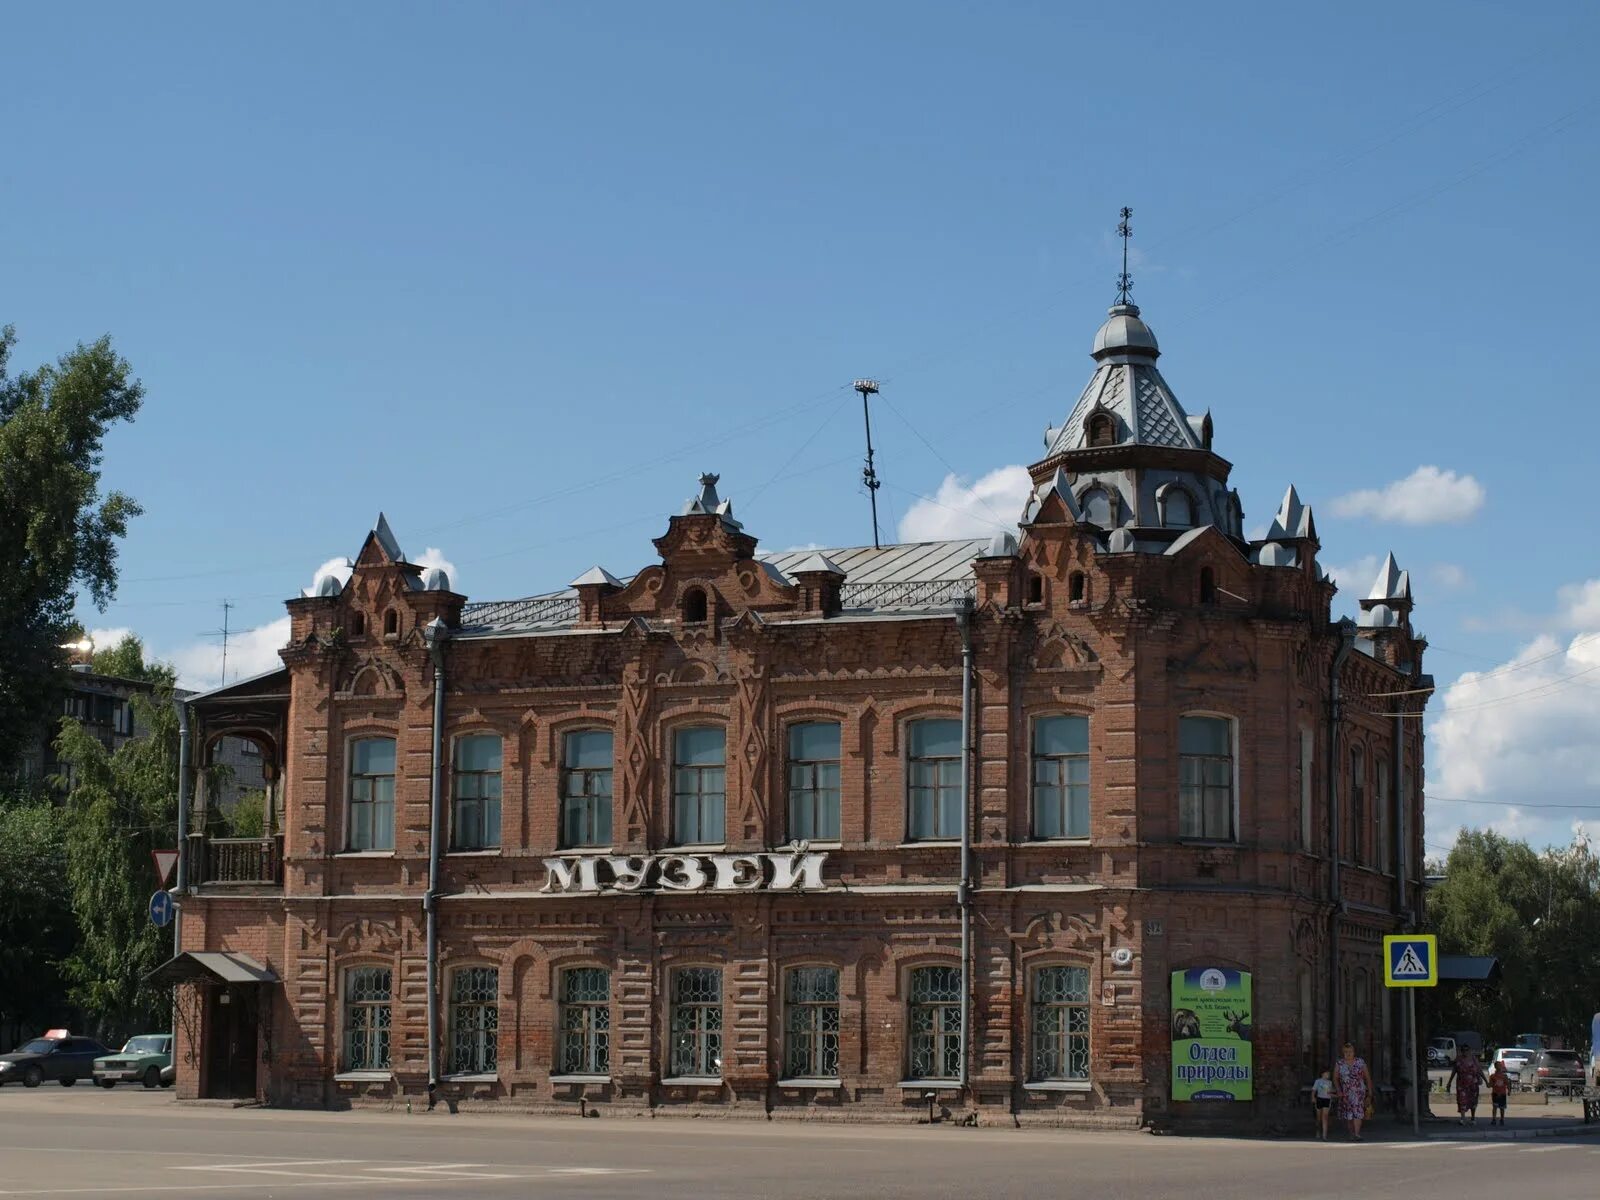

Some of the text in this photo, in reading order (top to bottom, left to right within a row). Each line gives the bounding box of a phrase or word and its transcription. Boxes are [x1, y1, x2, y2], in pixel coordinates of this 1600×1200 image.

[540, 840, 829, 893] МУЗЕЙ
[1189, 1043, 1236, 1062] Отдел
[1177, 1065, 1249, 1083] природы
